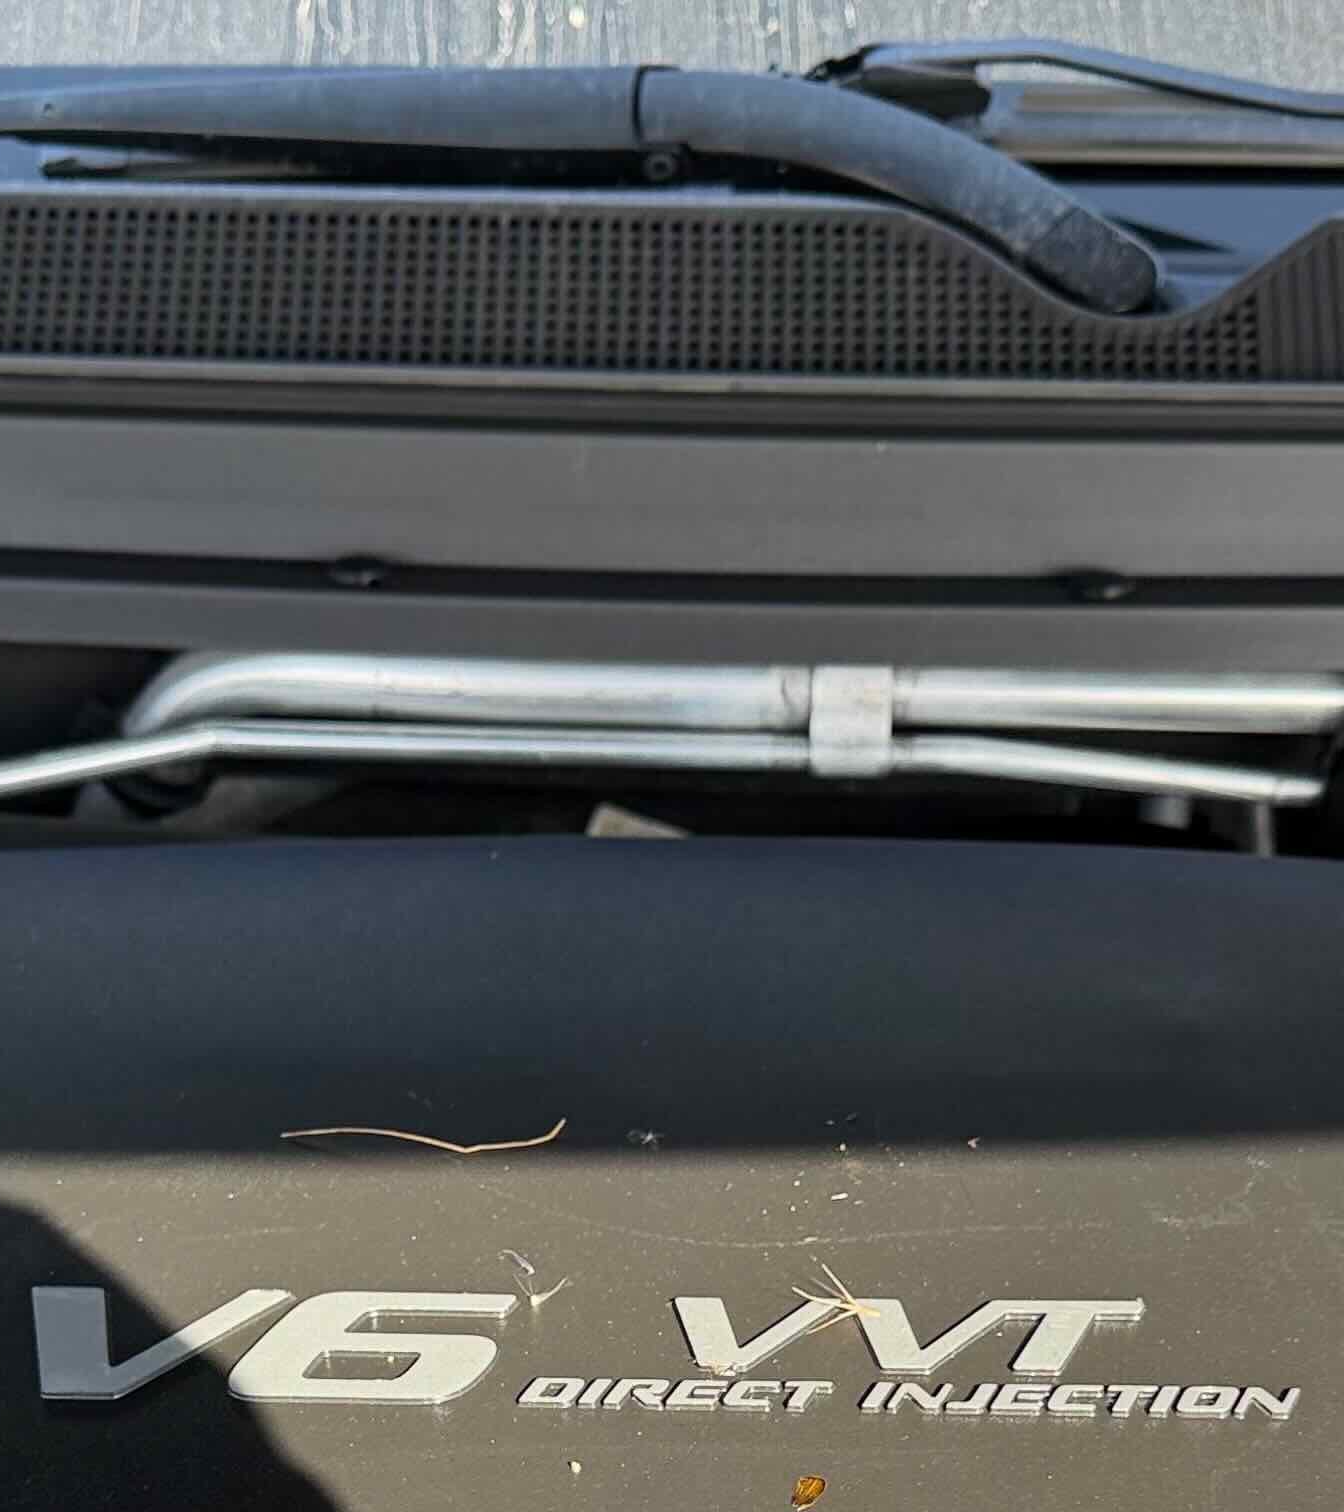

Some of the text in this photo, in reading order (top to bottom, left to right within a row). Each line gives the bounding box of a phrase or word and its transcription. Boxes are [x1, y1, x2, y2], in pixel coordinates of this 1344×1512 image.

[32, 1286, 1145, 1403] V6 VVT
[517, 1376, 1302, 1420] DIRECT INJECTION
